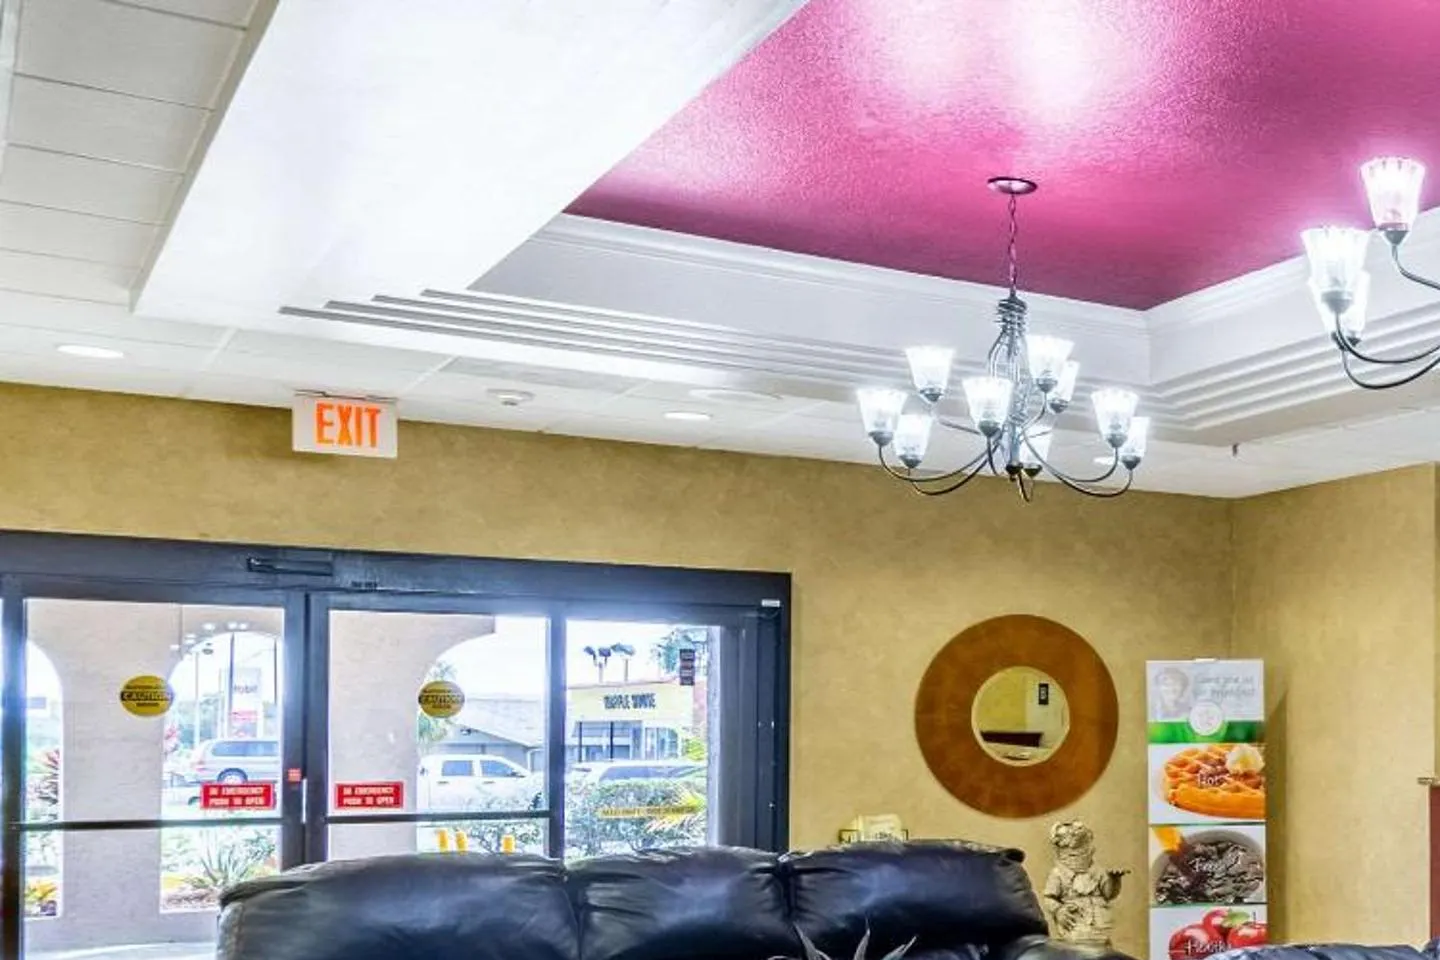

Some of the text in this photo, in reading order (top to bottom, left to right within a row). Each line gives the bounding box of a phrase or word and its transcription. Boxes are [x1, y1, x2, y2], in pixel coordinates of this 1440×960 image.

[315, 403, 381, 448] EXIT
[122, 691, 169, 700] CAUTION
[221, 786, 264, 795] EMERGENCY
[354, 786, 394, 795] EMERGENCY
